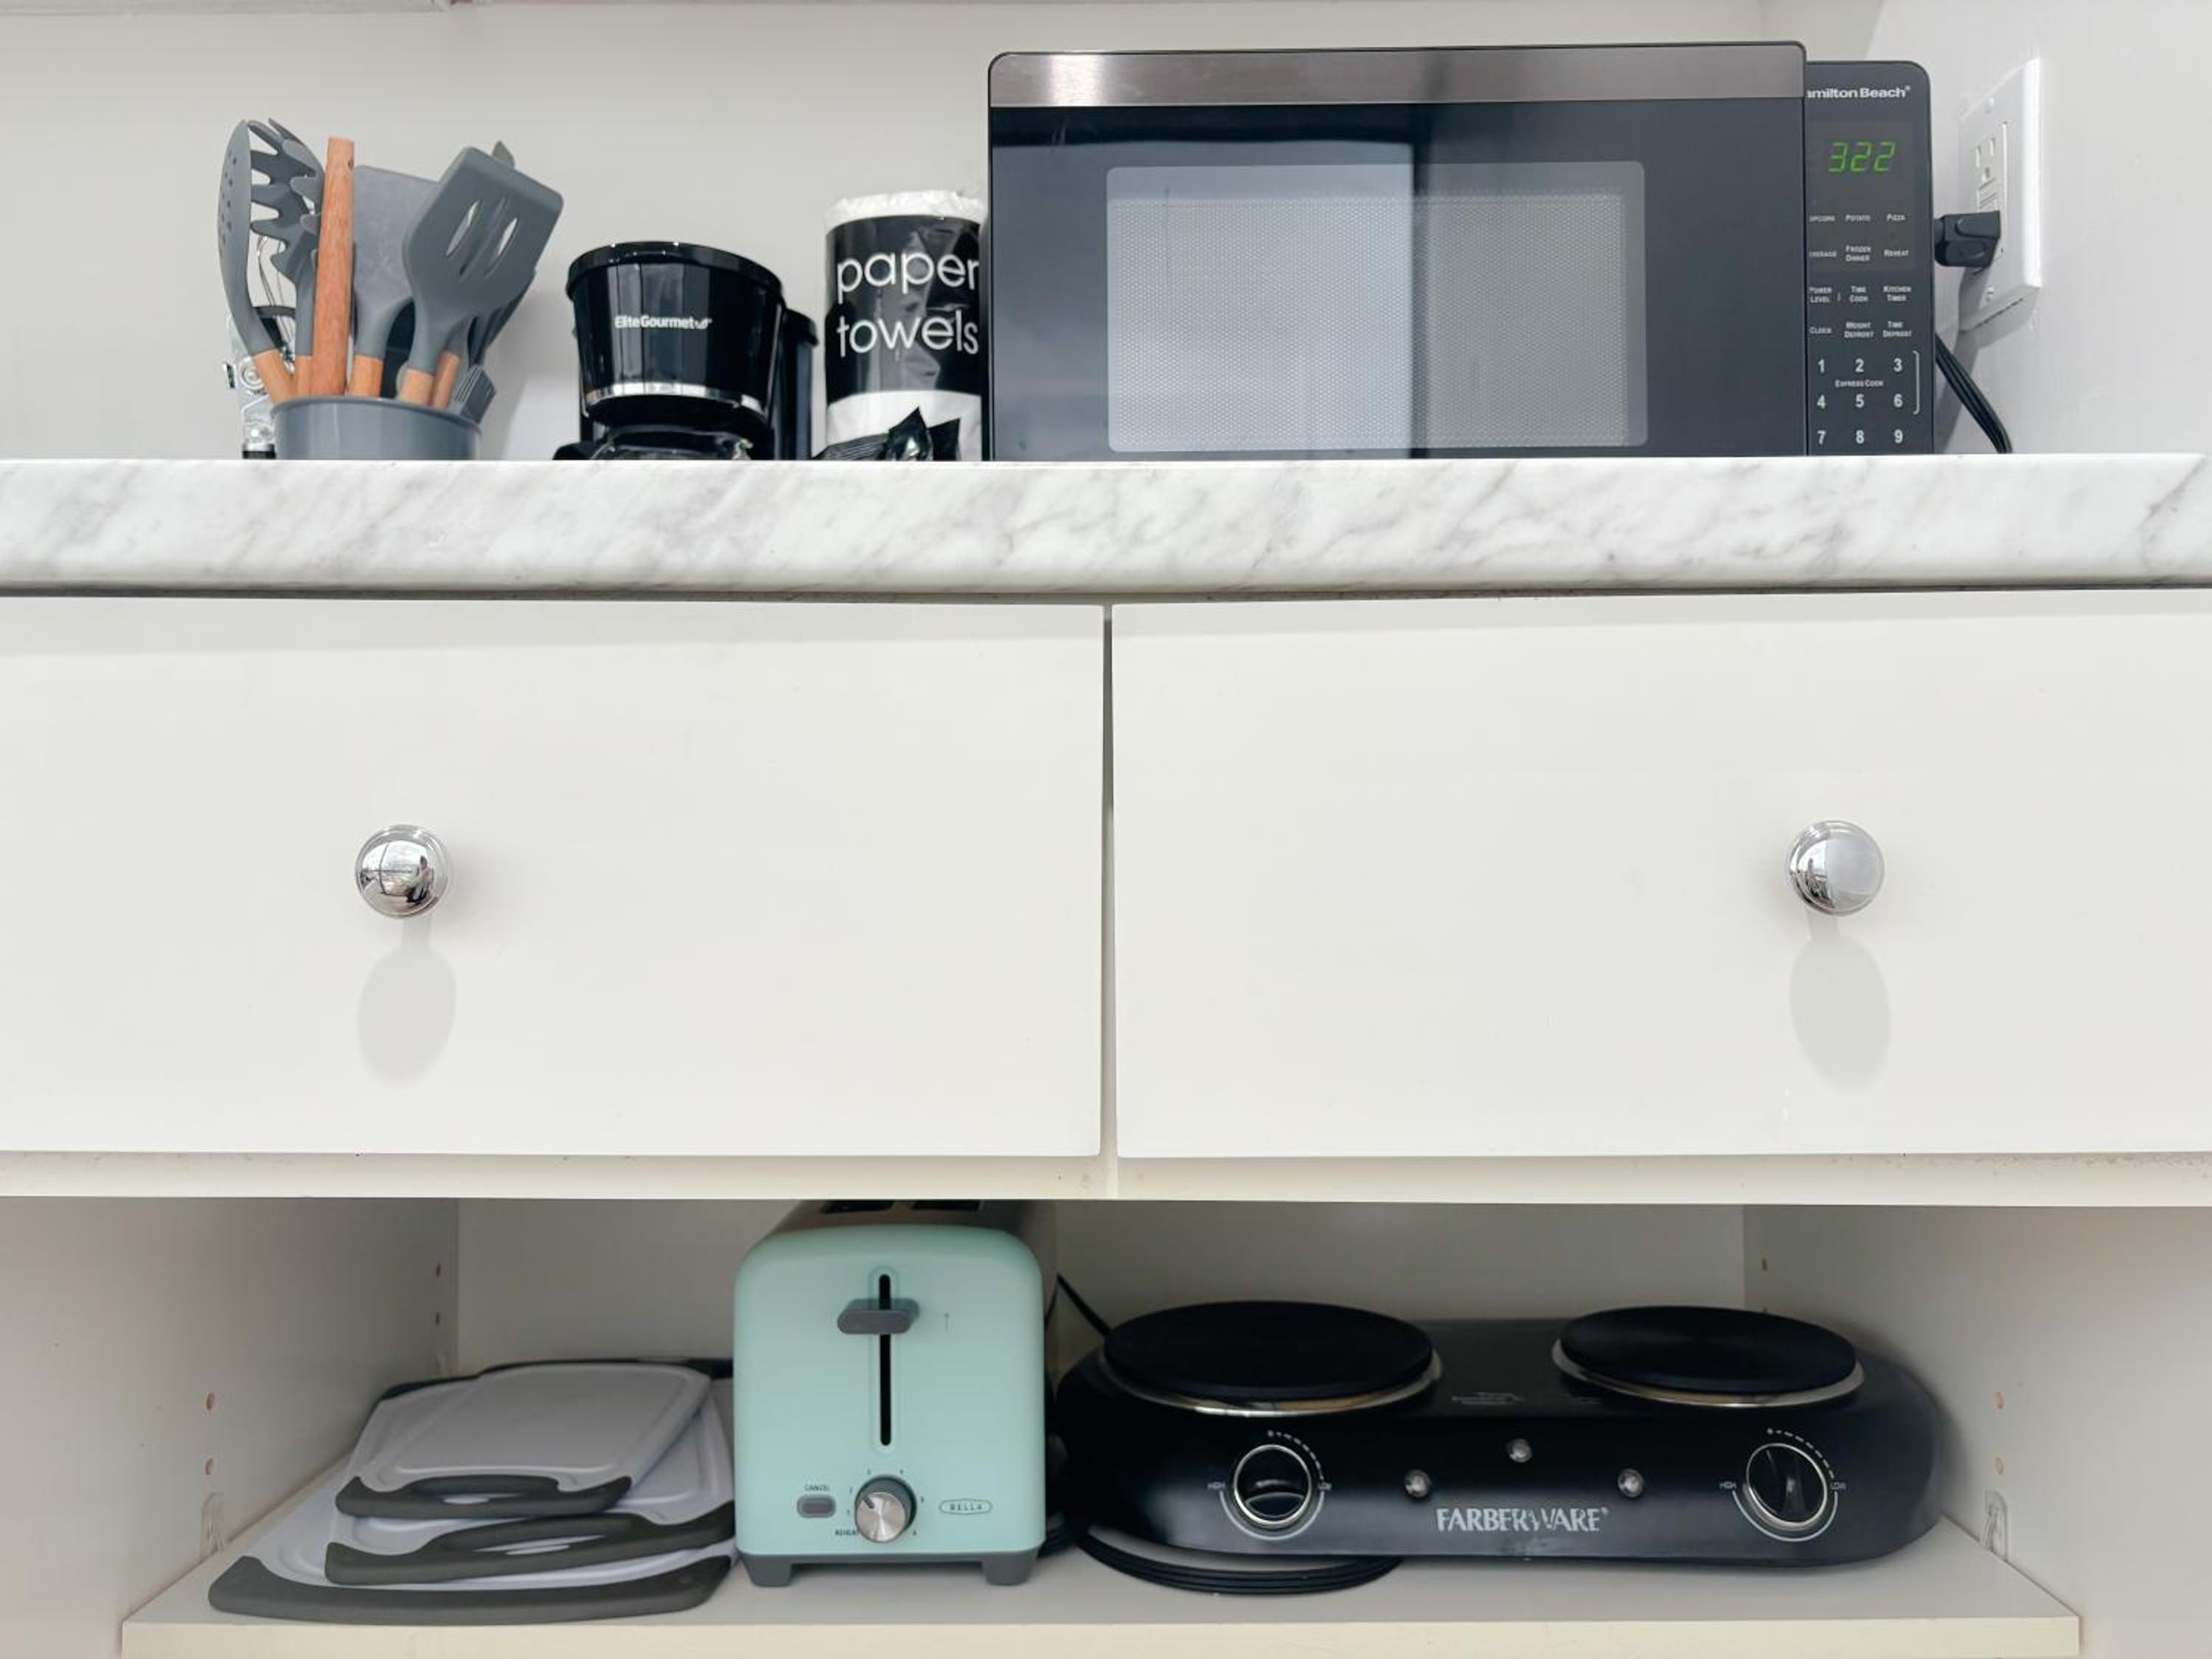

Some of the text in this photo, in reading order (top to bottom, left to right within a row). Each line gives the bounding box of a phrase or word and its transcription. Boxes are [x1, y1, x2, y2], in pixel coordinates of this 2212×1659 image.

[1806, 87, 1906, 98] milton Beach
[837, 252, 979, 305] paper
[836, 310, 979, 358] towels
[1818, 358, 1825, 373] 1
[1855, 358, 1864, 372] 2
[1893, 358, 1902, 372] 3
[1817, 394, 1826, 408] 4
[1855, 394, 1864, 408] 5
[1893, 394, 1902, 407] 6
[1817, 430, 1826, 445] 7
[1855, 430, 1865, 444] 8
[1894, 429, 1903, 444] 9
